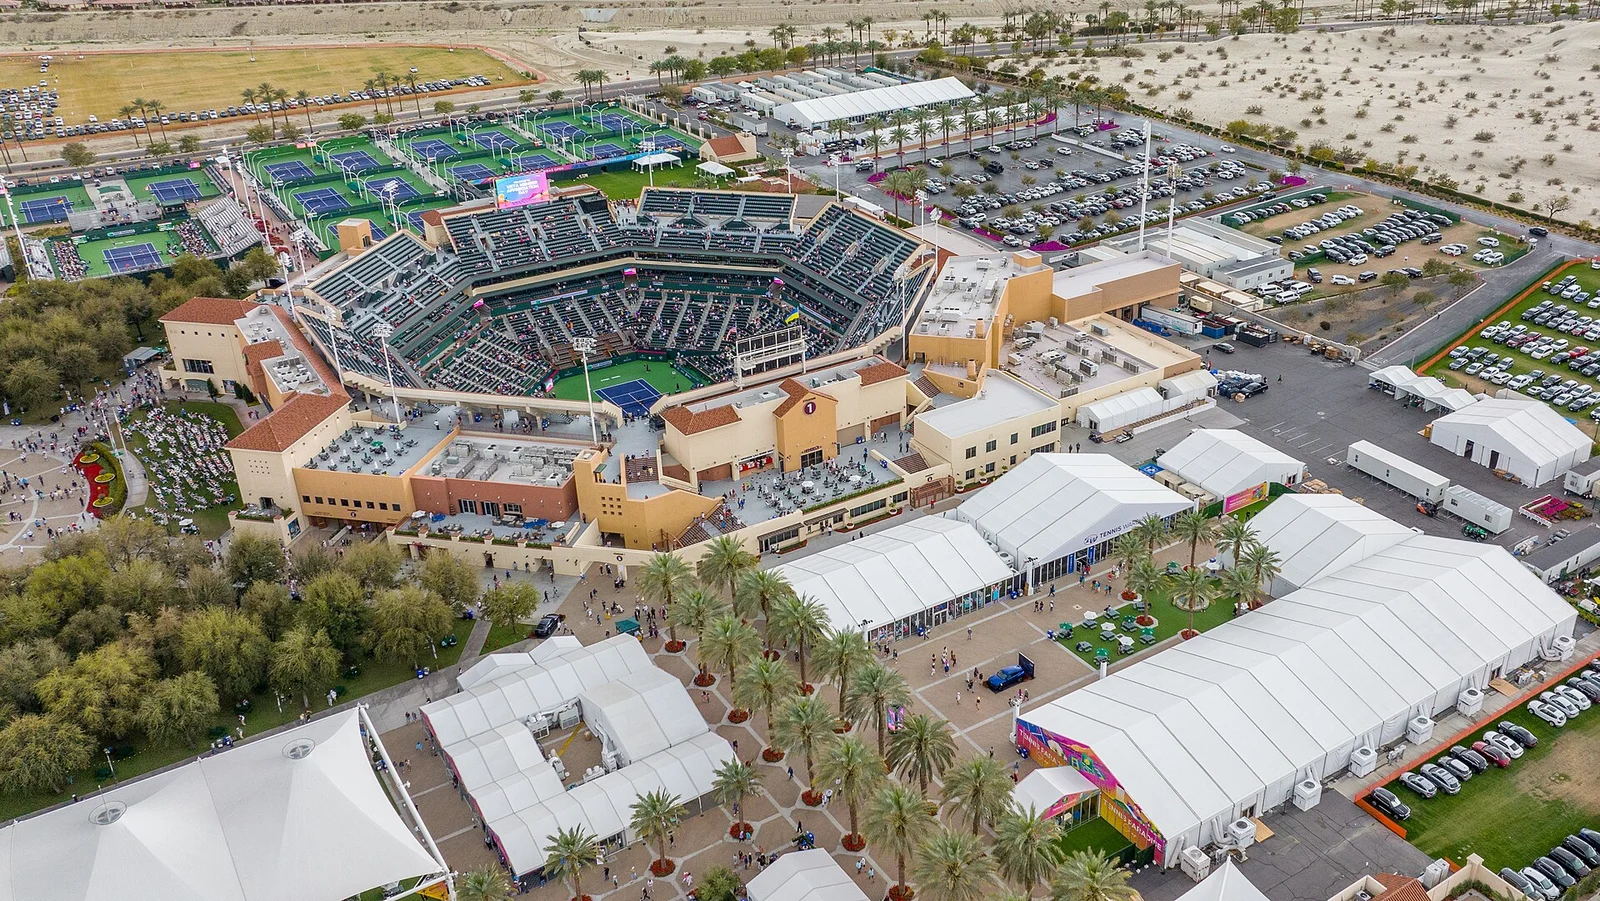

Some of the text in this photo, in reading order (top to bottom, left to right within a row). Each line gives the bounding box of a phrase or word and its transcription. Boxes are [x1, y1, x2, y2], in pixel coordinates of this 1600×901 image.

[807, 403, 813, 414] 1
[1100, 525, 1122, 539] TENNIS
[1019, 728, 1041, 751] TENNIS
[1104, 798, 1128, 823] TENNIS
